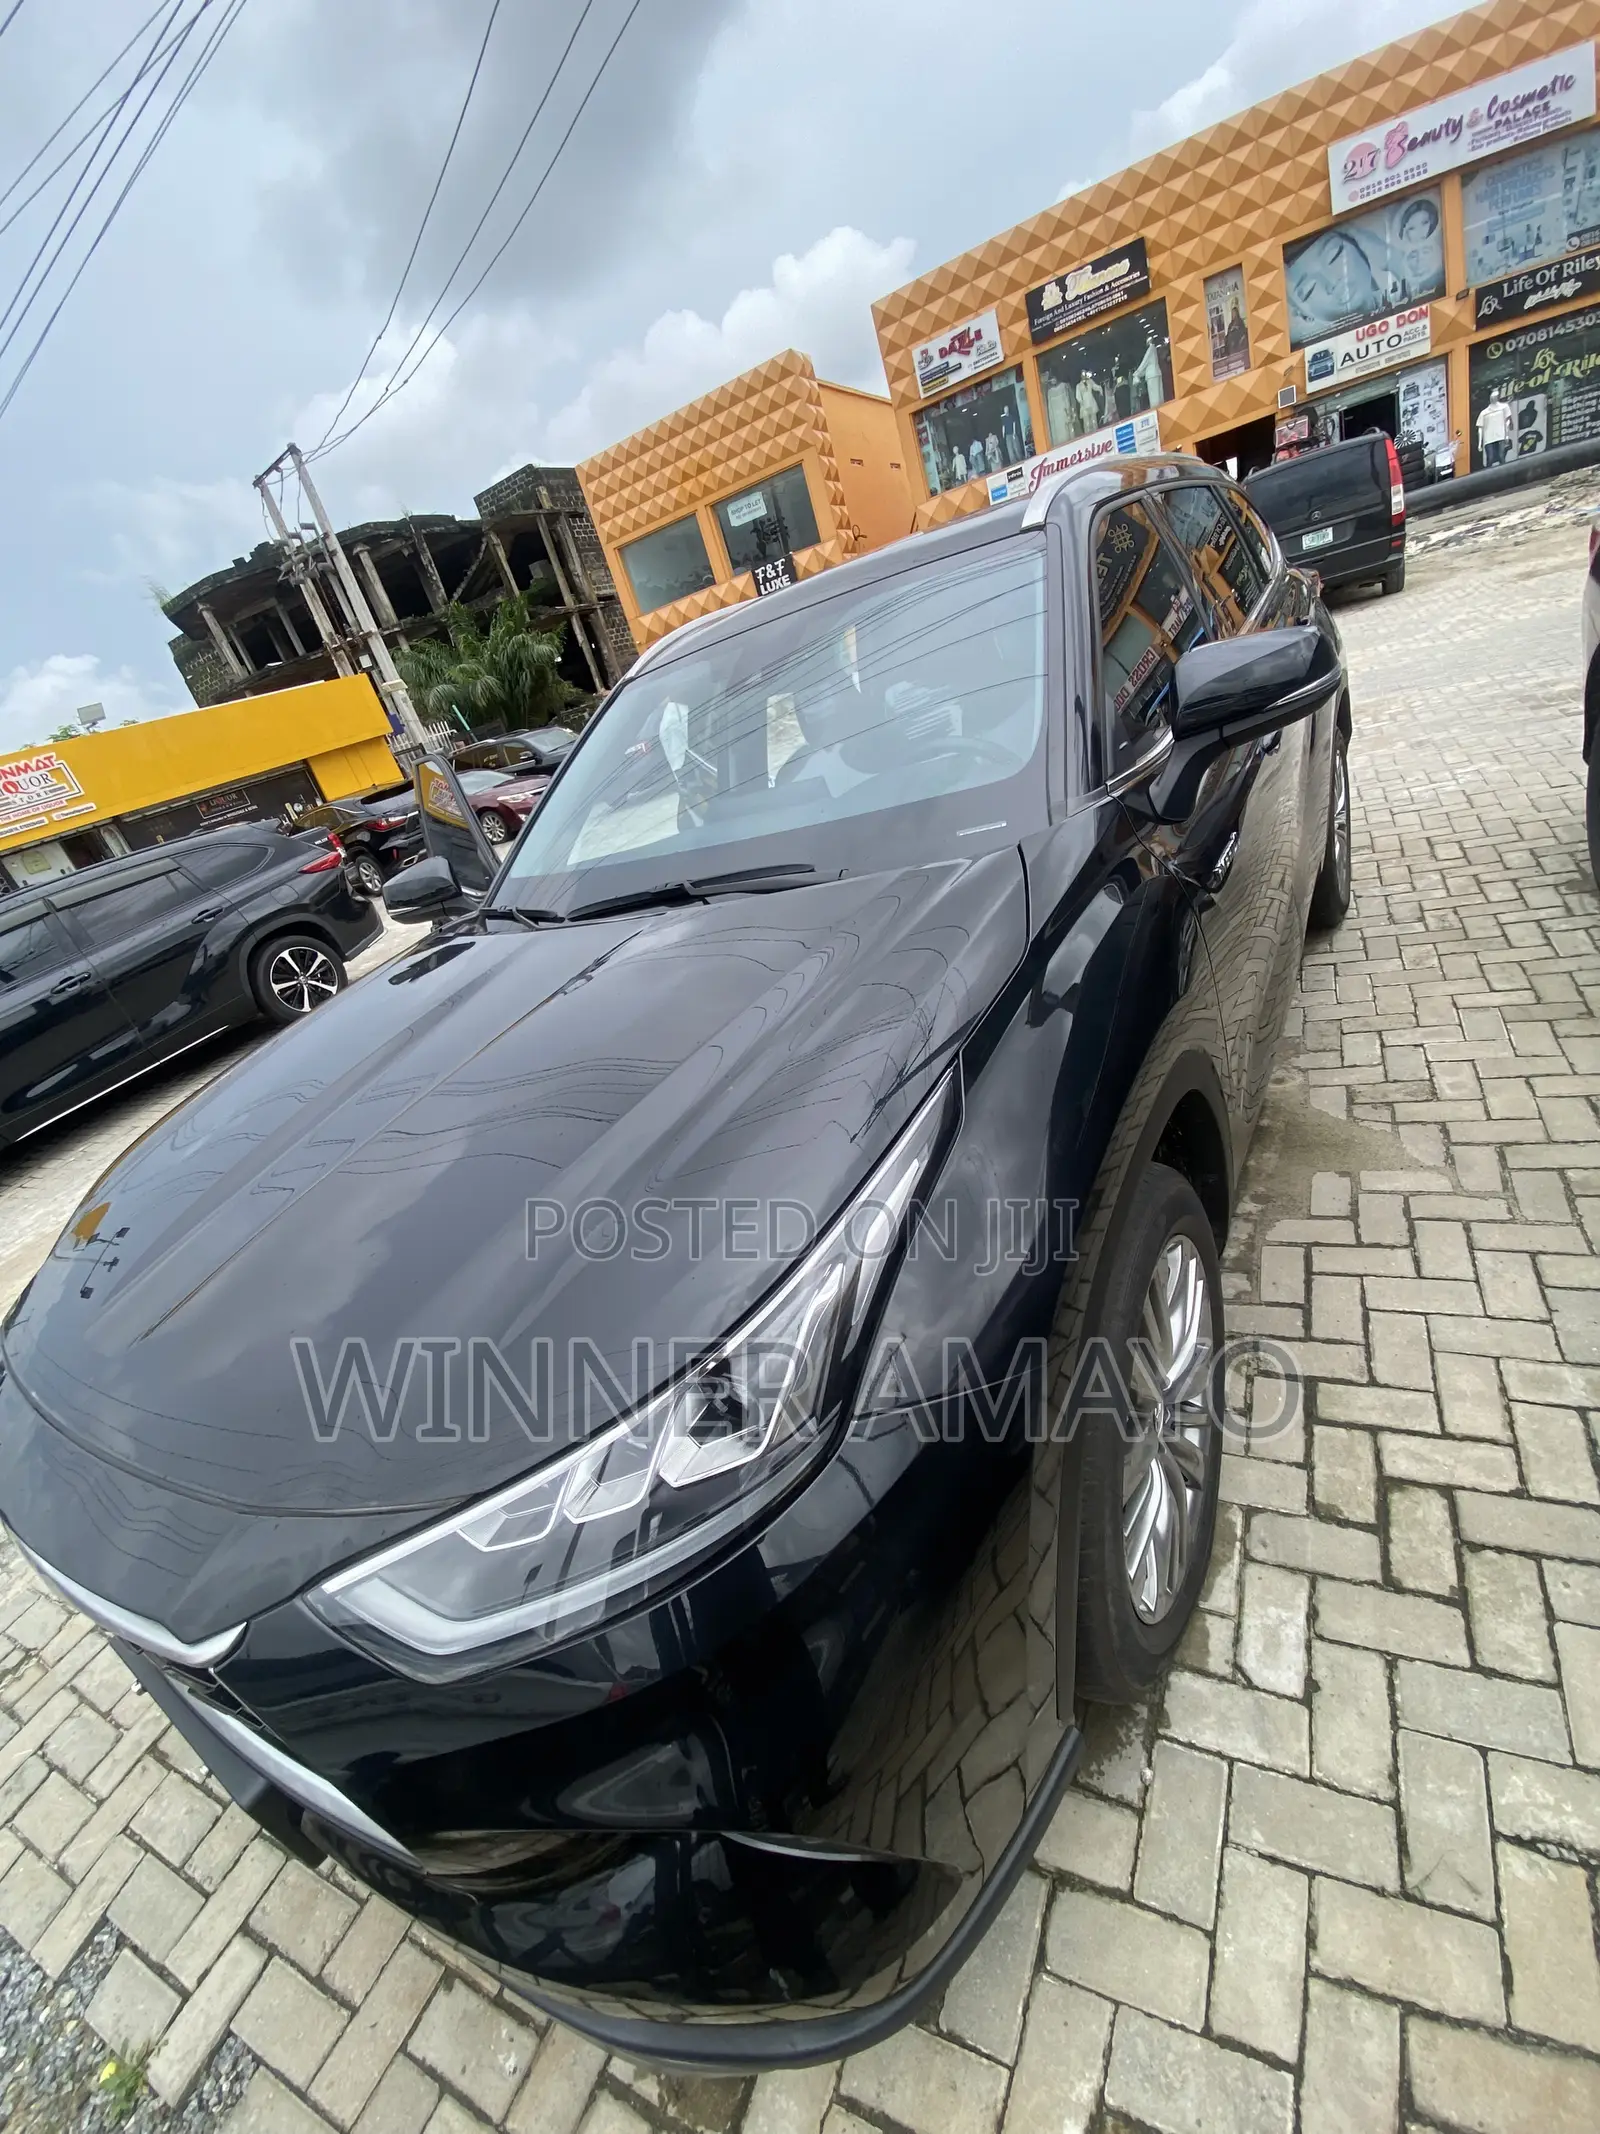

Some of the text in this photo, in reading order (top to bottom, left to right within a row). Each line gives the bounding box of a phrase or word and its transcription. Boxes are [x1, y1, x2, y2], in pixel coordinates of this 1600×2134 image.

[1384, 114, 1464, 170] Beauty
[1487, 73, 1577, 120] Cosmetic
[1494, 100, 1551, 130] PALACE
[1054, 304, 1065, 315] And
[1065, 299, 1083, 314] Luxury
[1084, 289, 1104, 302] Fashion
[1111, 271, 1141, 289] Accessories
[1502, 274, 1533, 298] Life
[1535, 264, 1560, 286] Of
[1355, 320, 1390, 342] UGO
[1396, 305, 1429, 329] DON
[1340, 334, 1402, 367] AUTO
[1028, 438, 1115, 493] Immersive
[754, 558, 786, 584] F&F
[760, 574, 791, 596] LUXE
[0, 755, 55, 781] NMAT
[11, 790, 50, 806] STORE
